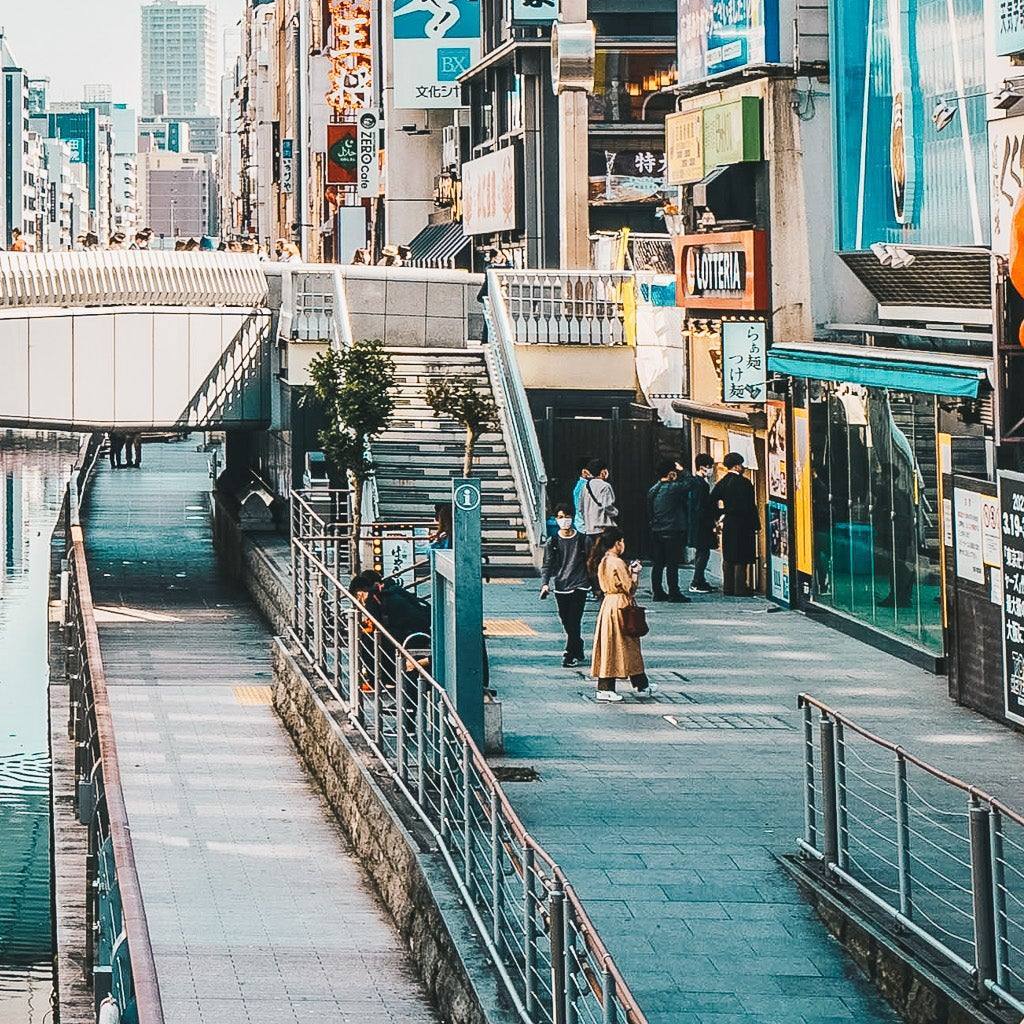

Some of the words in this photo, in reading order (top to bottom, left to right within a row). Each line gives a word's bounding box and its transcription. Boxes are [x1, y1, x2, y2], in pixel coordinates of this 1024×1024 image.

[442, 56, 465, 73] BX
[695, 251, 741, 290] LOTTERIA
[729, 354, 745, 399] つけ麺
